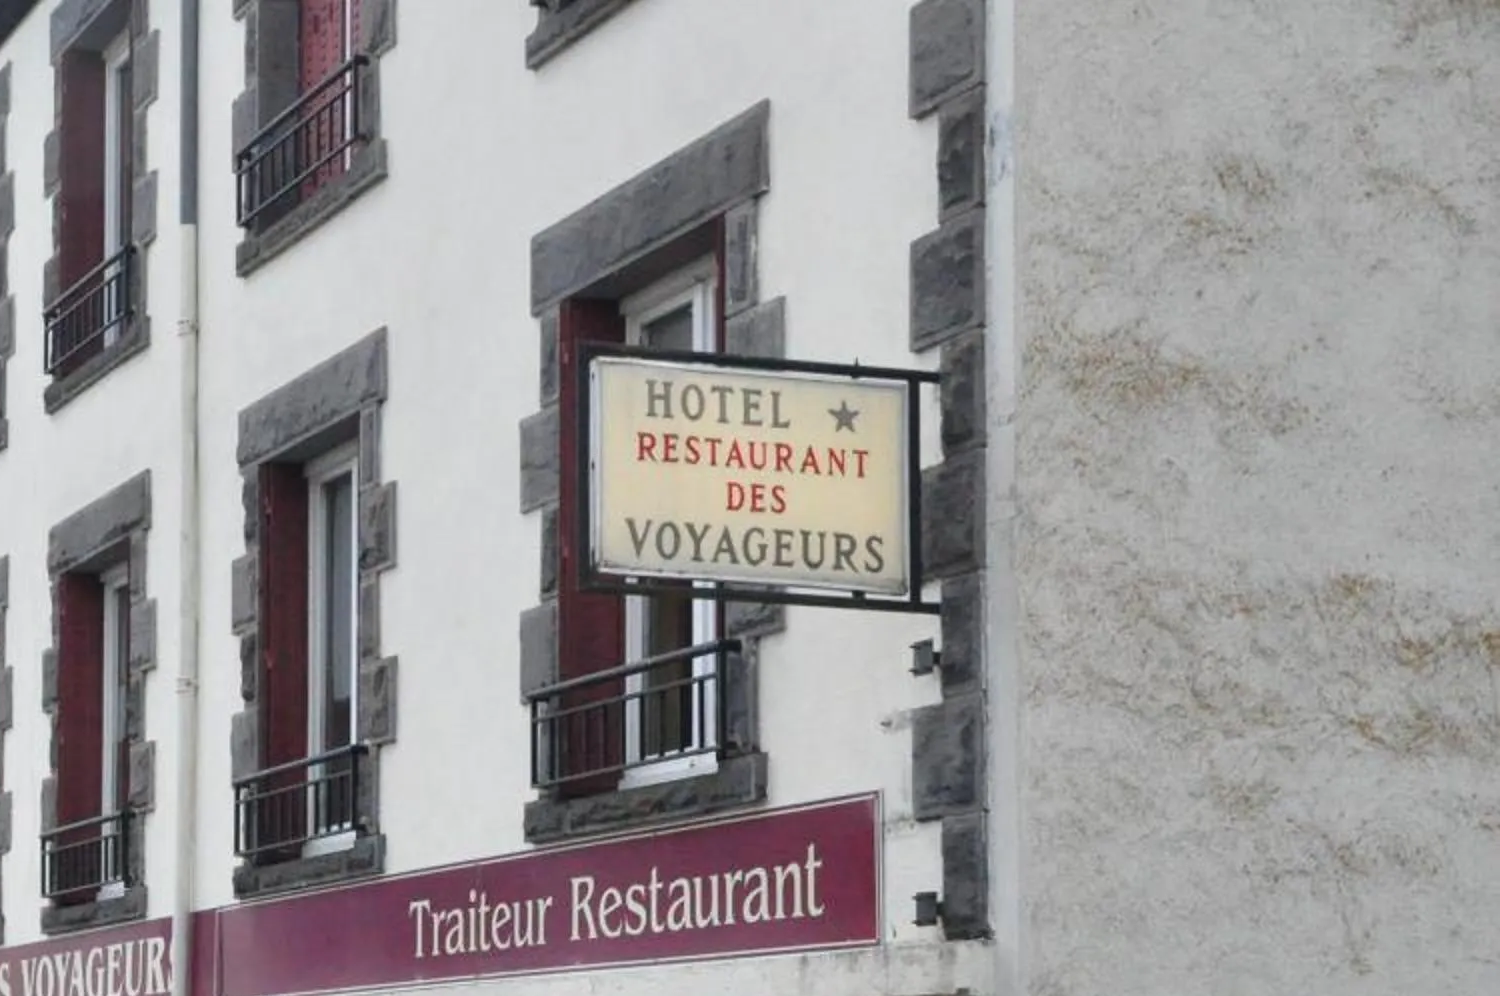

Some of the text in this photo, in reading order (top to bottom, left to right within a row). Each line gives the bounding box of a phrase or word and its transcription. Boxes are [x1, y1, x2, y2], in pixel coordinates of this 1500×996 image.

[645, 379, 791, 429] HOTEL
[636, 432, 869, 479] RESTAURANT
[726, 481, 787, 514] DES
[624, 517, 885, 574] VOYAGEURS
[409, 841, 826, 958] Traiteur Restaurant
